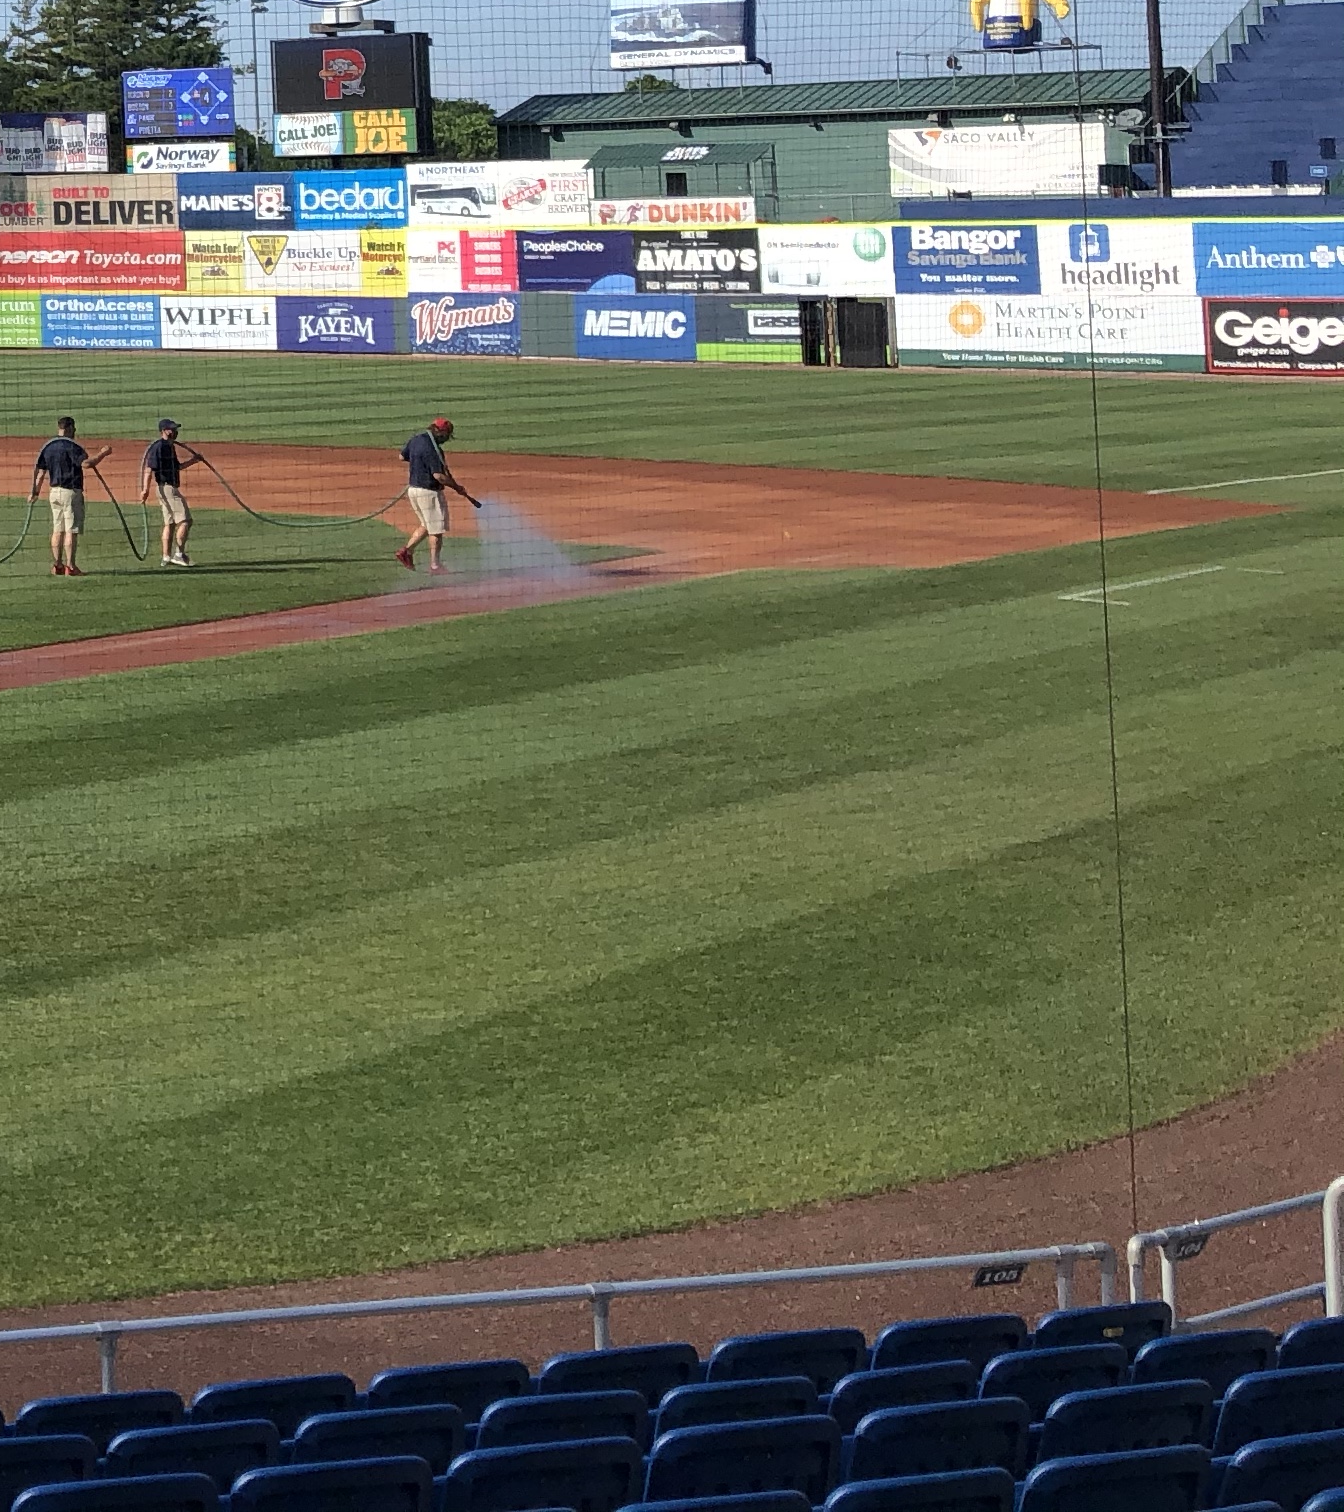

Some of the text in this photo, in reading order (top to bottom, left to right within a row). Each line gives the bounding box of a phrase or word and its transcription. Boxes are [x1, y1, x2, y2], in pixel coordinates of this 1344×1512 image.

[619, 48, 735, 60] GENERAL DYNAMICS
[353, 109, 406, 126] CALL
[279, 123, 337, 142] CALL JOE!
[355, 126, 407, 153] JOE
[943, 130, 1035, 143] SACO VALLEY
[47, 138, 63, 146] BUD
[156, 147, 220, 163] Norway
[156, 162, 184, 171] Savings
[426, 166, 485, 175] NORTHEAST
[52, 186, 110, 199] BUILT TO
[551, 180, 587, 191] FIRST
[181, 195, 254, 211] MAINE'S
[300, 181, 404, 210] bedard
[53, 200, 174, 226] DELIVER
[648, 202, 748, 223] DUNKIN'
[192, 243, 238, 253] Watch For
[438, 241, 456, 254] PG
[523, 240, 603, 254] PeoplesChoice
[912, 226, 1021, 254] Bangor
[83, 249, 181, 268] Toyota.com
[187, 253, 242, 263] Motorcycles
[287, 247, 333, 259] Buckle
[338, 246, 360, 260] Up.
[636, 249, 757, 271] AMATO'S
[908, 250, 1027, 267] Savings Bank
[1206, 245, 1307, 269] Anthem
[291, 262, 355, 272] No Excuses!
[7, 274, 26, 285] buy
[28, 274, 35, 284] is
[37, 275, 48, 284] as
[50, 274, 99, 286] important
[101, 275, 111, 284] as
[113, 274, 137, 284] what
[138, 275, 157, 286] you
[158, 274, 180, 285] buy!
[920, 273, 1020, 283] You matter more.
[1061, 263, 1181, 292] headlight
[45, 298, 153, 313] OrthoAccess
[996, 302, 1147, 320] MARTIN'S POINT
[412, 296, 515, 345] Wyman's
[584, 309, 687, 339] MEMIC
[298, 315, 375, 345] KAYEM
[996, 323, 1130, 339] HEALTH CARE
[1215, 307, 1344, 355] Geige
[53, 336, 154, 348] Ortho-Access.com
[982, 1270, 1018, 1284] 105
